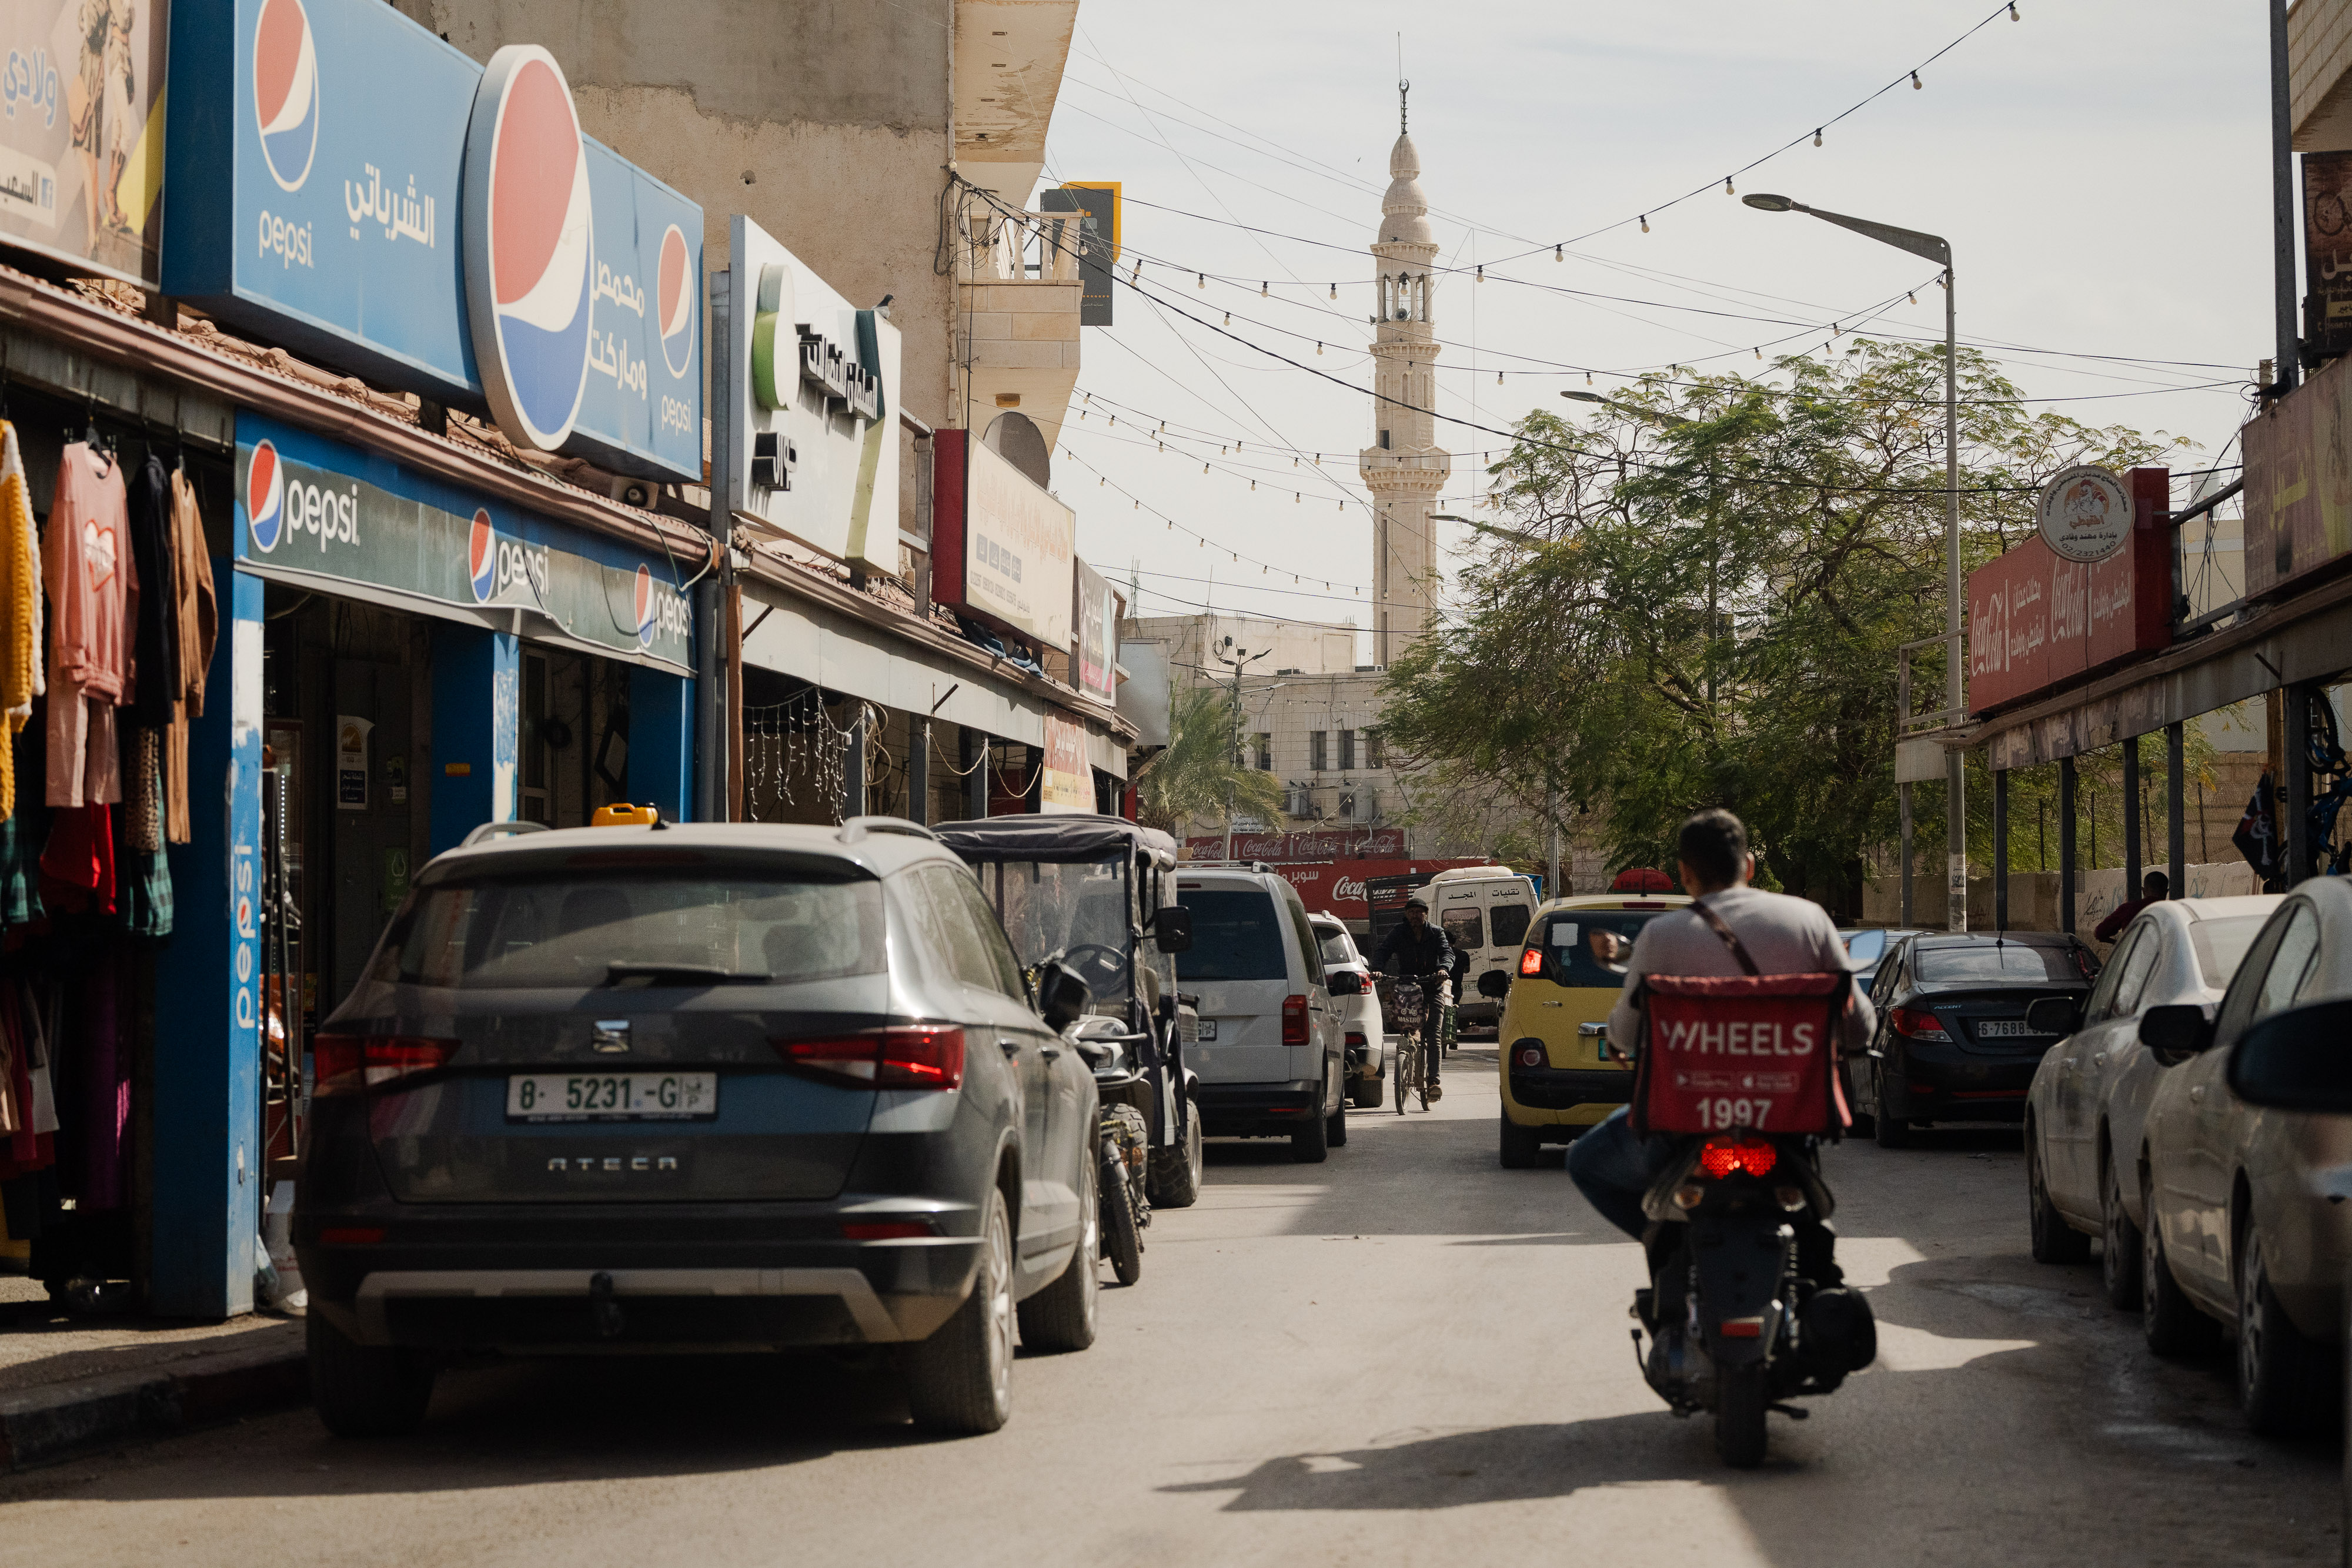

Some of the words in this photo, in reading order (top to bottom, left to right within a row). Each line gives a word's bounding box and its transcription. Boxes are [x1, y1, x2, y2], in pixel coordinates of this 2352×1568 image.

[345, 163, 435, 249] الشرباتي
[259, 210, 312, 269] pepsi
[593, 259, 645, 318] محمص
[589, 329, 647, 401] وماركت
[662, 394, 692, 437] pepsi
[286, 479, 358, 553] pepsi
[2062, 540, 2116, 557] 02/2321440
[497, 540, 549, 597] pepsi
[1190, 841, 1223, 860] Coca-Col
[1290, 871, 1318, 884] سوبر
[1448, 891, 1476, 900] المجد
[1492, 888, 1520, 898] نقليات
[235, 845, 255, 1029] pepsi
[1660, 1020, 1814, 1055] WHEELS
[1696, 1096, 1773, 1130] 1997
[547, 1157, 677, 1171] ATECA
